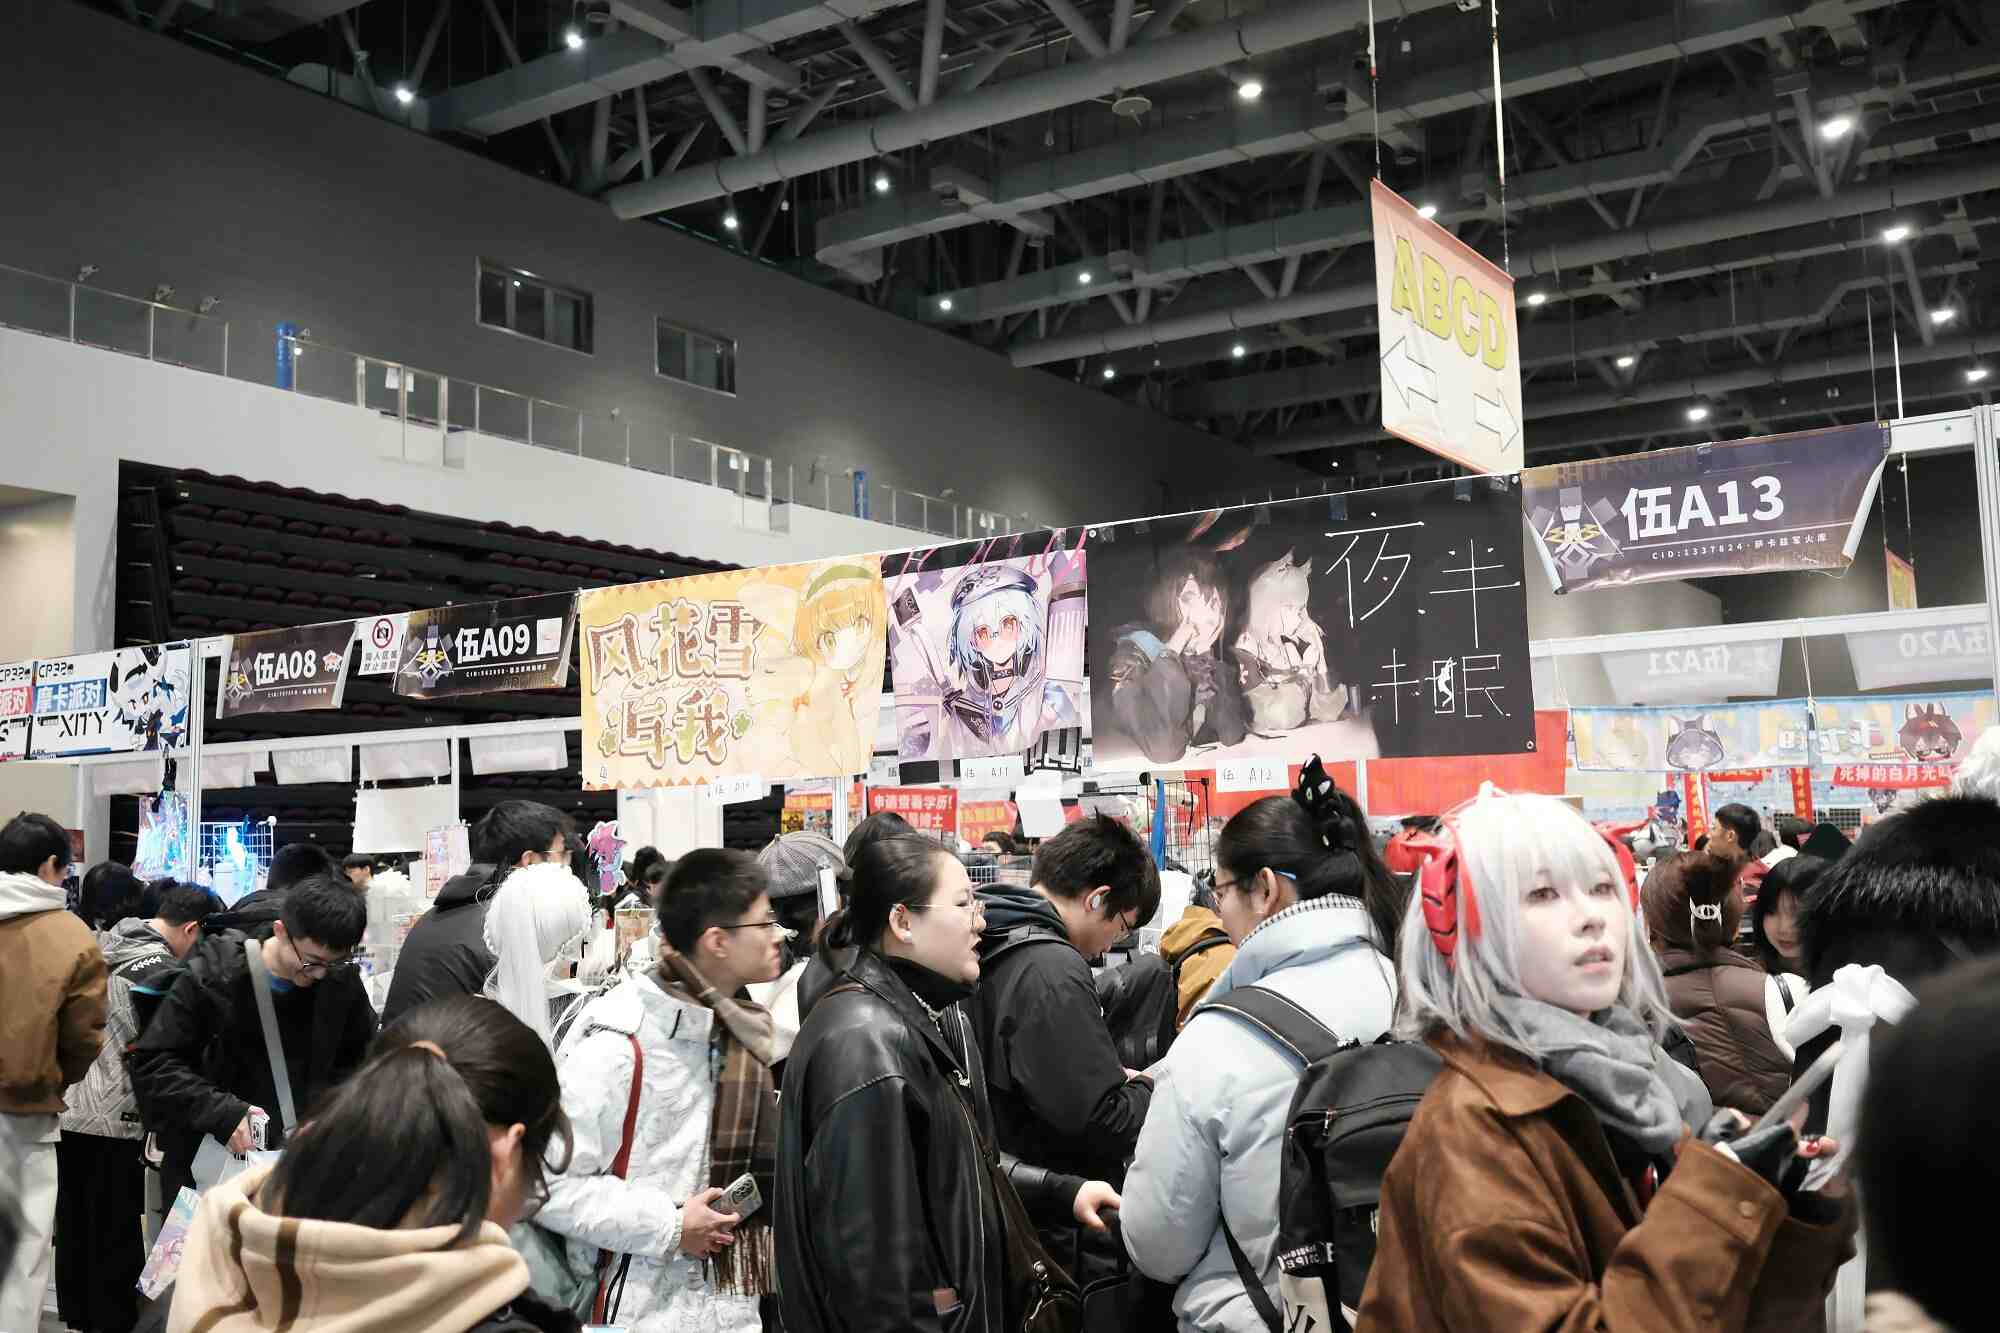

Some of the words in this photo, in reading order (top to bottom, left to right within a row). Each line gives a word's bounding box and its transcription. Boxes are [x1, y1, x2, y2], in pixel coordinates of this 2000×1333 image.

[1391, 235, 1506, 371] ABCD
[1620, 475, 1785, 541] 伍A13
[254, 649, 317, 686] 伍A08
[454, 623, 531, 664] 伍A09
